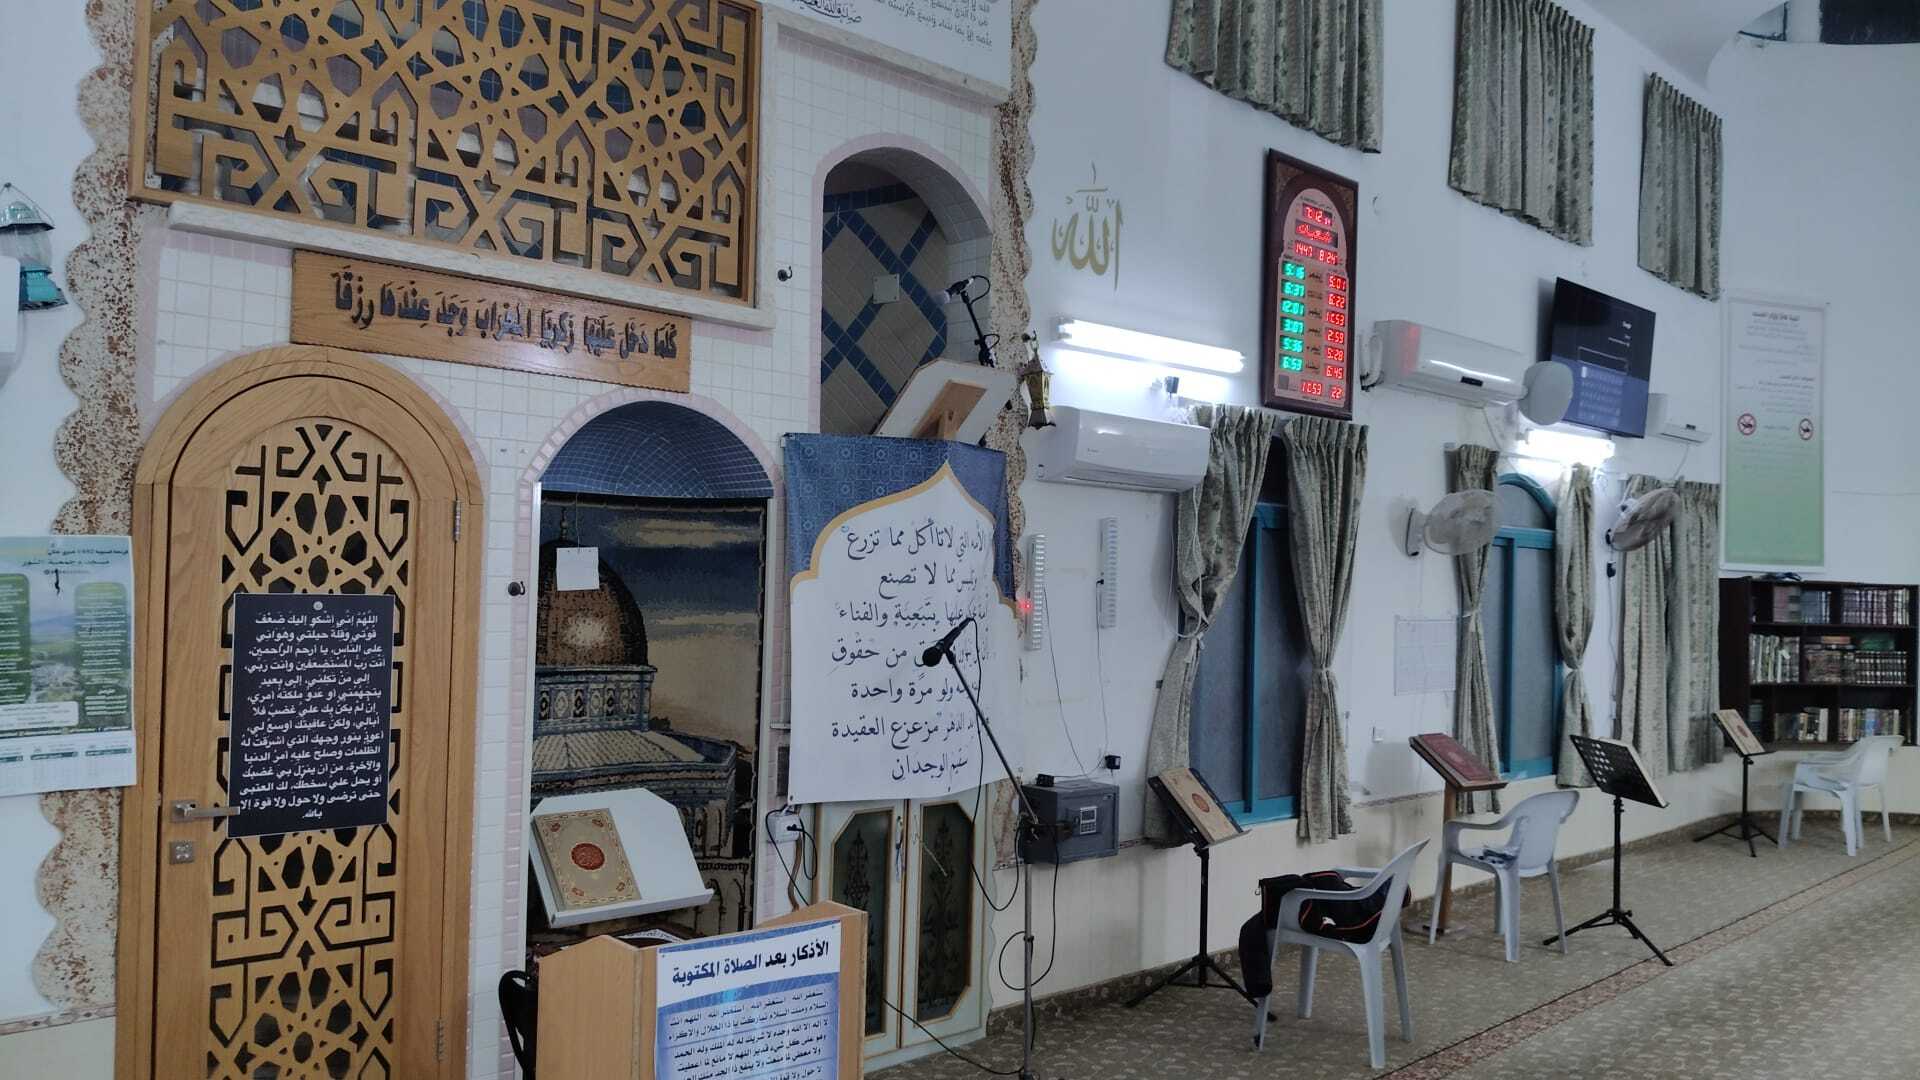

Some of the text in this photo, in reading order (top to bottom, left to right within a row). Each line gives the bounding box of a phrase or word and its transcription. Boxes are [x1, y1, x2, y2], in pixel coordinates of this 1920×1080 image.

[1295, 242, 1313, 257] 1447
[923, 560, 937, 585] لا
[878, 567, 917, 600] تصنع
[296, 629, 329, 643] حيلتي
[320, 644, 329, 656] يا
[363, 644, 384, 656] على
[831, 637, 880, 666] حقوق
[886, 647, 907, 668] من
[296, 659, 352, 671] المستضعفين
[354, 661, 368, 670] رب
[260, 678, 283, 689] بعيد
[338, 671, 352, 685] من
[304, 689, 325, 702] عدو
[851, 678, 903, 704] واحدة
[908, 681, 933, 704] مرة
[252, 706, 267, 717] فلا
[321, 704, 334, 716] بك
[335, 702, 353, 714] يكن
[354, 702, 365, 717] لم
[294, 719, 328, 732] عافيتك
[328, 717, 351, 730] ولكن
[831, 714, 885, 743] العقيدة
[240, 734, 251, 747] له
[286, 734, 309, 749] الذي
[311, 733, 339, 746] وجهك
[290, 750, 312, 763] عليه
[313, 748, 343, 761] وصلح
[344, 745, 381, 757] الظلمات
[244, 751, 271, 765] الدنيا
[242, 765, 275, 780] غضبك
[293, 764, 316, 778] ينزل
[330, 763, 345, 775] من
[892, 752, 948, 781] الوجدان
[276, 768, 292, 779] بي
[276, 781, 289, 791] لك
[350, 776, 371, 788] يحل
[239, 782, 274, 796] العتبى
[358, 789, 381, 801] حتى
[273, 796, 287, 809] ولا
[288, 795, 311, 807] حول
[312, 793, 325, 806] ولا
[326, 790, 357, 804] ترضى
[253, 798, 272, 810] قوة
[672, 938, 829, 987] الأذكار بعد الصلاة المكتوبة
